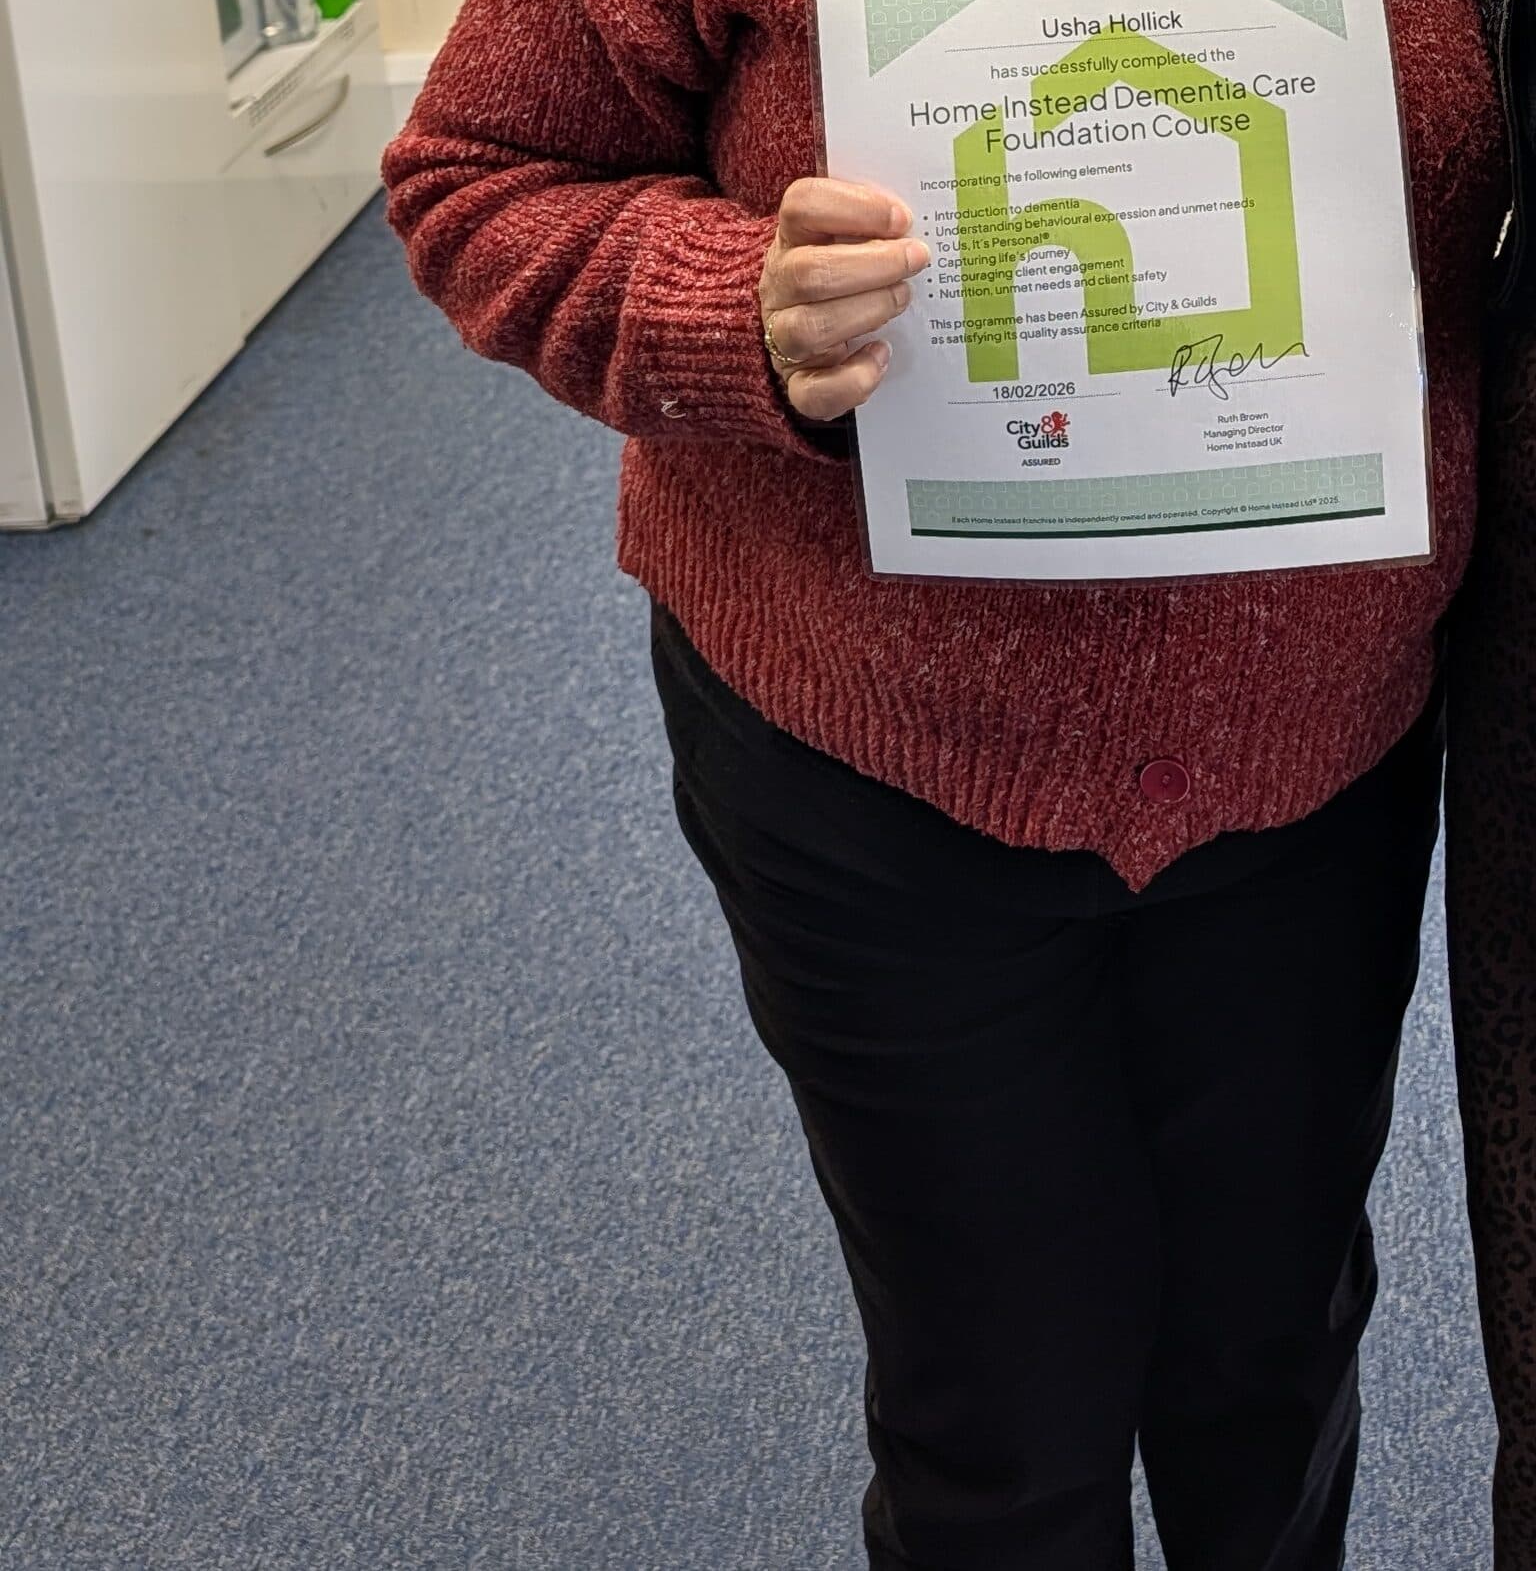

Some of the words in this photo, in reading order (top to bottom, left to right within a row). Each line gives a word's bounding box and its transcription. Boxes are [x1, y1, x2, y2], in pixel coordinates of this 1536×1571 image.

[1042, 16, 1102, 38] Usha
[1109, 10, 1183, 34] Hollick
[990, 66, 1018, 79] has
[1021, 56, 1118, 77] successfully
[1121, 48, 1208, 70] completed
[1210, 48, 1235, 62] the
[910, 101, 997, 127] Home
[1004, 87, 1107, 119] Instead
[1114, 77, 1246, 110] Dementia
[1252, 74, 1316, 98] Care
[985, 119, 1146, 153] Foundation
[1152, 113, 1250, 138] Course
[920, 174, 1001, 191] Incorporating
[1003, 171, 1022, 184] the
[1024, 166, 1078, 182] following
[1079, 162, 1133, 177] elements
[934, 205, 1008, 222] Introduction
[1009, 204, 1022, 215] to
[1024, 198, 1080, 214] dementia
[935, 220, 1023, 238] Understanding
[1024, 213, 1092, 230] behavioural
[1094, 207, 1156, 223] expression
[1158, 204, 1180, 217] and
[1181, 201, 1218, 214] unmet
[1220, 197, 1255, 211] needs
[936, 241, 950, 252] To
[952, 239, 971, 252] Us,
[937, 253, 997, 270] Capturing
[999, 250, 1026, 264] life's
[1027, 248, 1071, 264] journey
[938, 268, 1013, 285] Encouraging
[1015, 264, 1048, 277] client
[1049, 258, 1125, 275] engagement
[939, 285, 993, 299] Nutrition,
[995, 283, 1033, 296] unmet
[1034, 278, 1072, 291] needs
[1073, 275, 1096, 288] and
[1097, 273, 1130, 286] client
[1132, 270, 1167, 284] safety
[929, 319, 952, 330] This
[954, 315, 1023, 330] programme
[1025, 313, 1046, 323] has
[1047, 310, 1078, 322] been
[1080, 304, 1127, 318] Assured
[1129, 304, 1144, 316] by
[1145, 301, 1169, 313] City
[1171, 299, 1179, 310] &
[1181, 296, 1217, 309] Guilds
[931, 335, 944, 345] as
[946, 331, 1002, 345] satisfying
[1003, 331, 1018, 341] its
[1019, 327, 1059, 341] quality
[1060, 323, 1119, 337] assurance
[1122, 318, 1161, 331] criteria
[993, 382, 1075, 400] 18/02/2026
[1217, 414, 1239, 424] Ruth
[1240, 412, 1269, 423] Brown
[1017, 434, 1069, 450] Guilds
[1203, 428, 1246, 439] Managing
[1248, 424, 1284, 434] Director
[1206, 442, 1234, 452] Home
[1235, 439, 1268, 449] Instead
[1269, 437, 1282, 446] UK
[1021, 458, 1061, 467] ASSURED
[971, 516, 993, 524] Home
[1023, 516, 1056, 525] franchise
[1058, 516, 1064, 524] is
[1065, 514, 1119, 525] independently
[1120, 513, 1146, 521] owned
[1147, 512, 1162, 520] and
[1201, 506, 1239, 516] Copyright
[1248, 504, 1270, 512] Home
[1272, 501, 1299, 510] Instead
